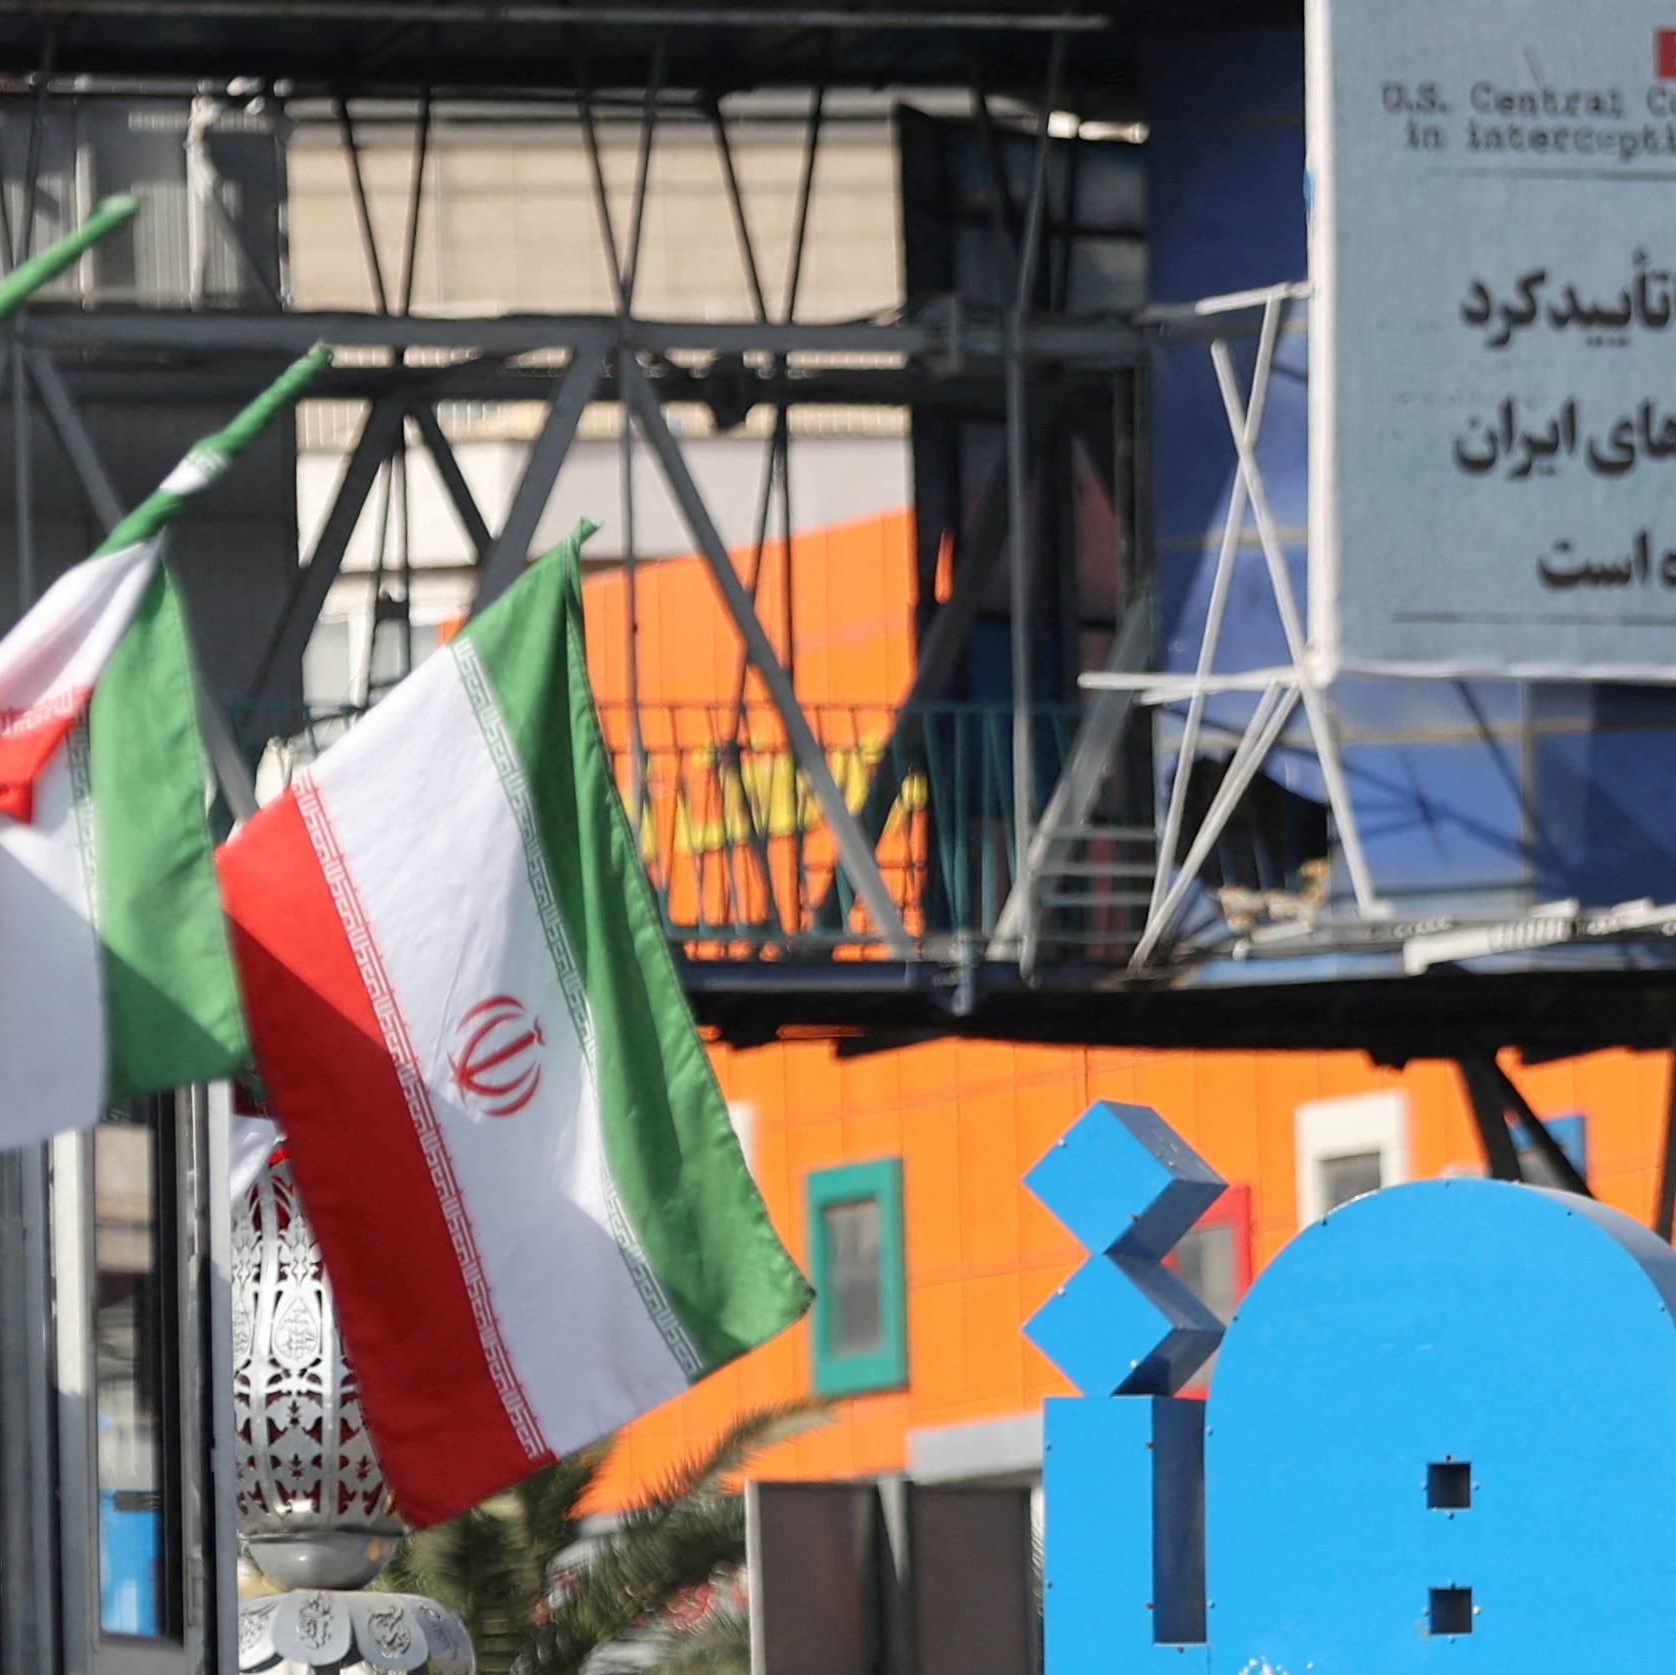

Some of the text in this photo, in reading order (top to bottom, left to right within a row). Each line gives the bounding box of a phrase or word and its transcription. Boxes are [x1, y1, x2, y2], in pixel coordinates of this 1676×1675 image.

[1382, 80, 1449, 116] U.S.
[1470, 81, 1624, 119] Central
[1406, 117, 1442, 152] in
[1460, 269, 1547, 351] کرد
[1452, 397, 1579, 484] ایران
[1535, 528, 1653, 592] است
